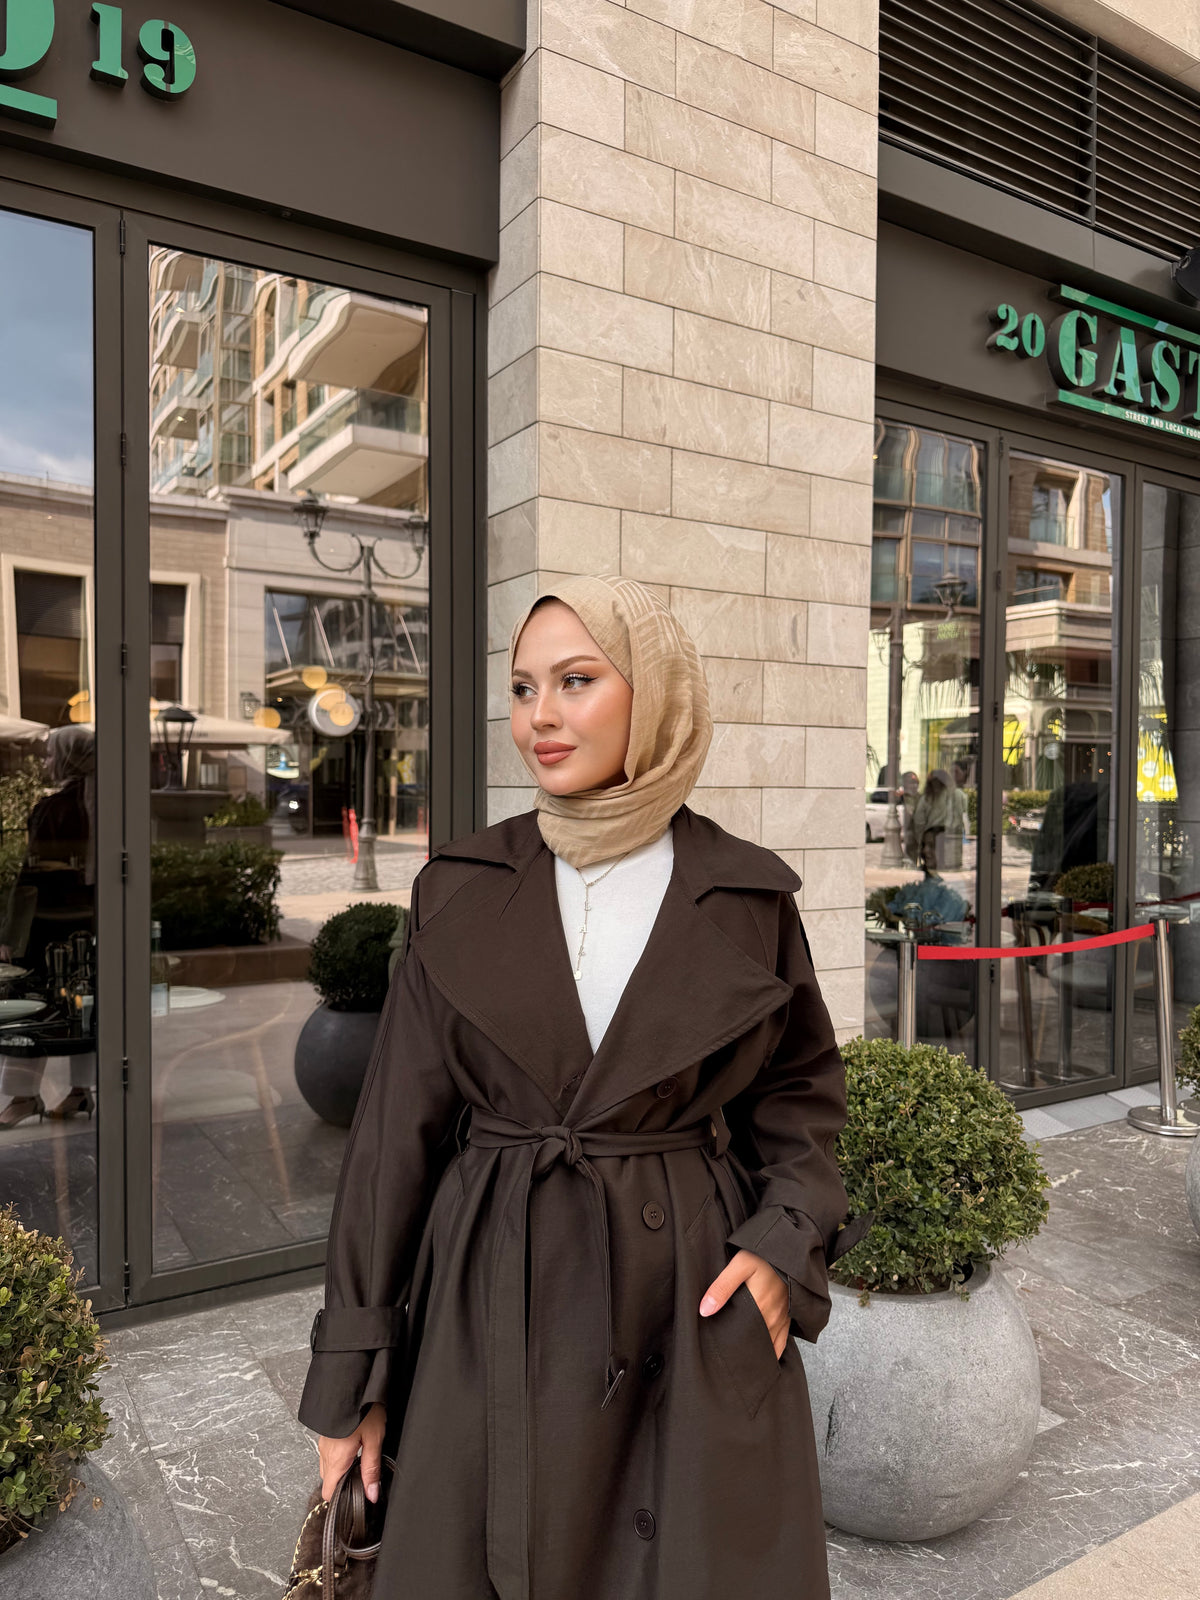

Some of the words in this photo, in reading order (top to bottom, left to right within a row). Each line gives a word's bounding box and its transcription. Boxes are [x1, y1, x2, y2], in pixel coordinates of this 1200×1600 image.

[91, 2, 197, 94] 19
[996, 303, 1046, 358] 20
[1125, 410, 1149, 424] STREET
[1151, 417, 1164, 428] AND
[1165, 421, 1185, 435] LOCAL
